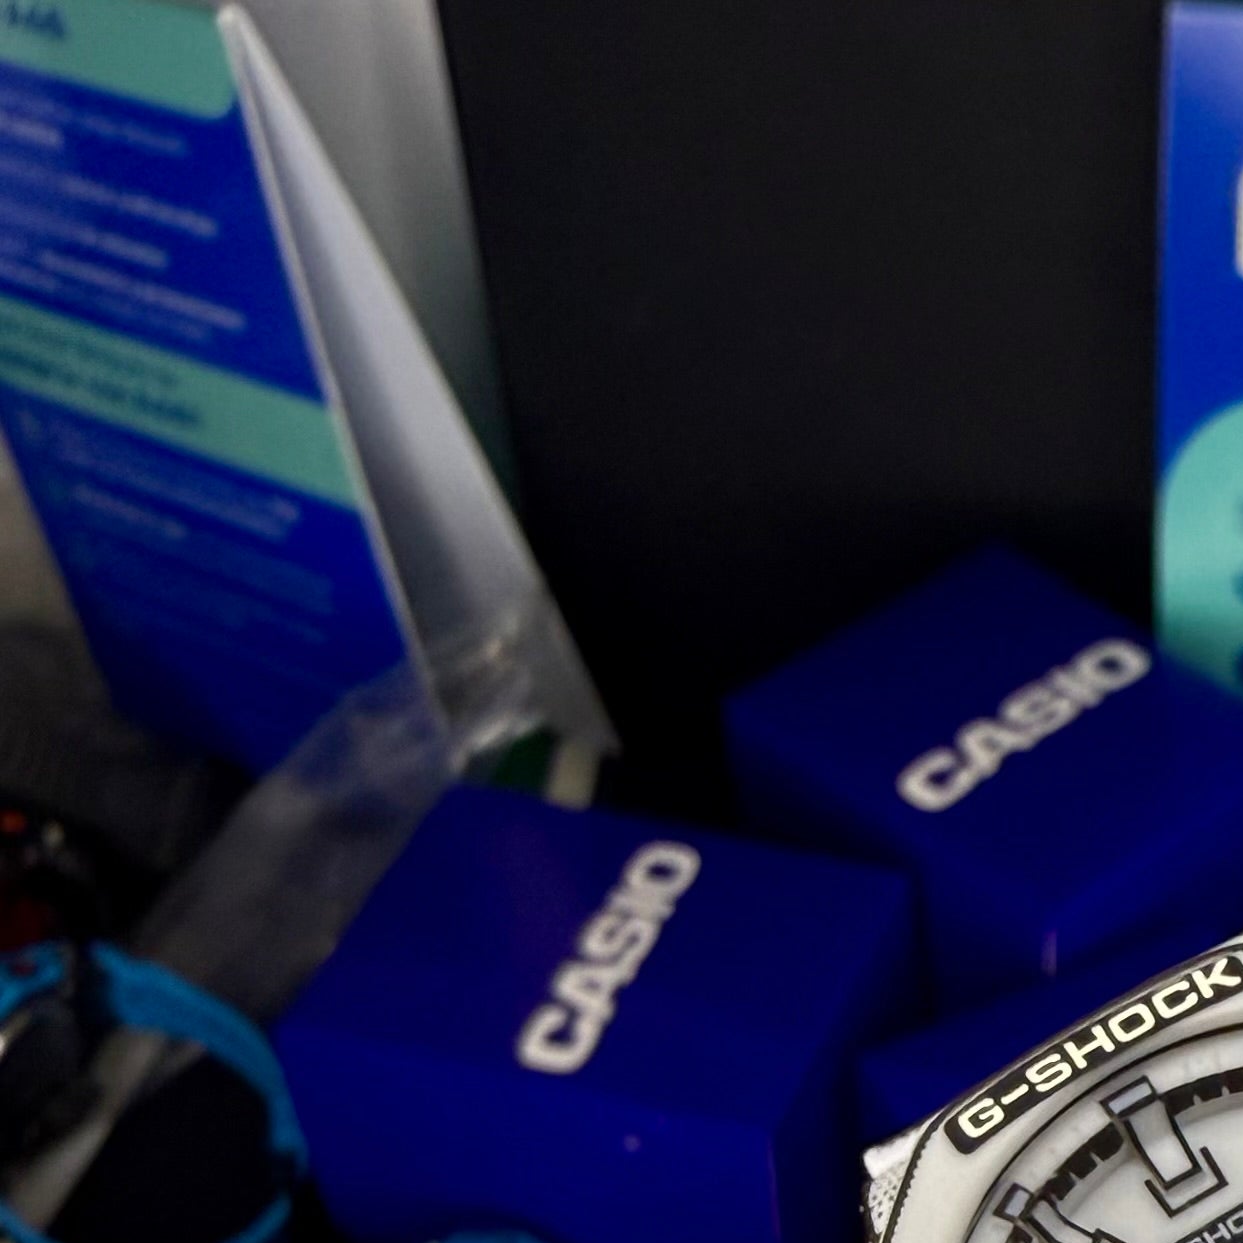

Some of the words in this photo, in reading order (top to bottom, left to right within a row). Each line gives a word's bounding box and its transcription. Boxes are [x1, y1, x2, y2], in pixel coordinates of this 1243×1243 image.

[897, 637, 1151, 812] CASIO
[516, 841, 702, 1075] CASIO
[957, 957, 1242, 1139] G-SHOCK
